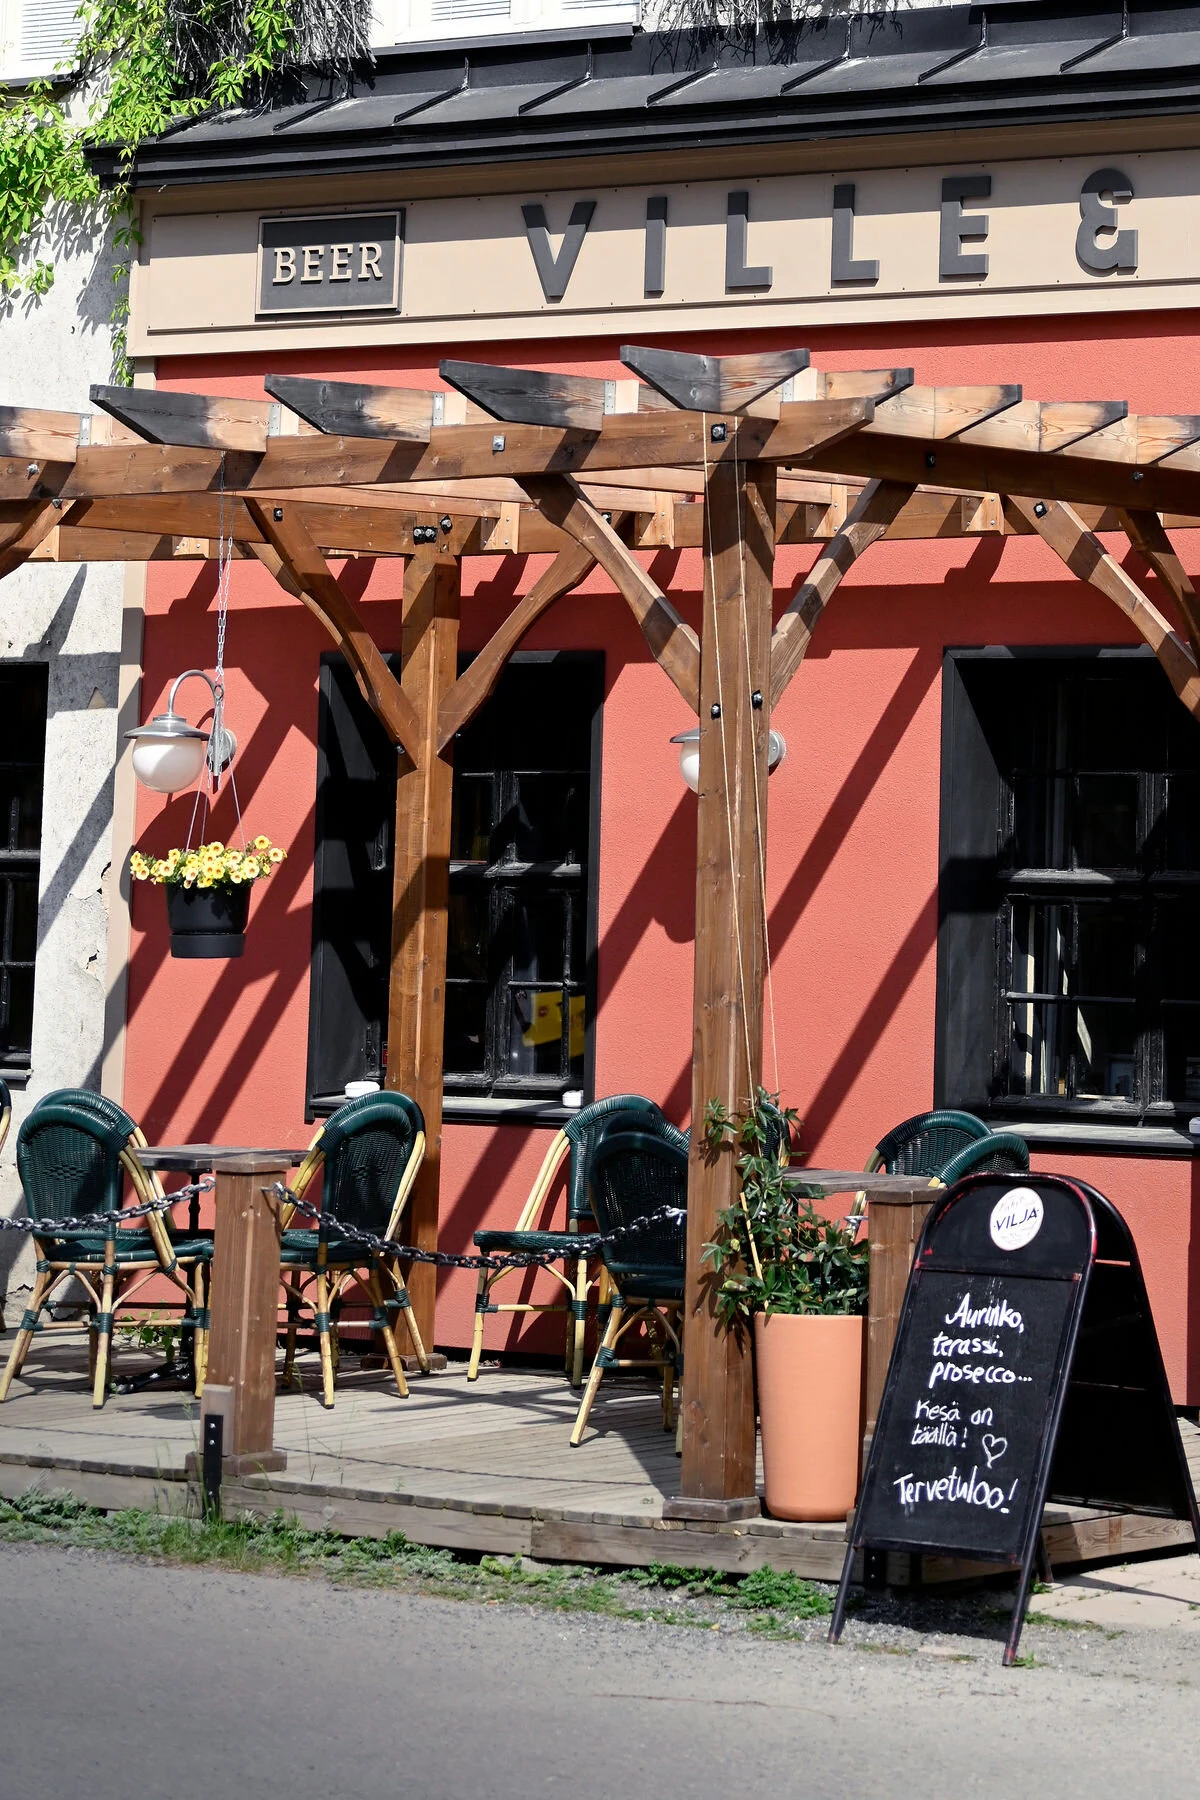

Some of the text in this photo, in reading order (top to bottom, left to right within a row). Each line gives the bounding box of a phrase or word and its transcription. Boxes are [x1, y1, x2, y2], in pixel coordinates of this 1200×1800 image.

[520, 175, 992, 304] VILLE
[1075, 167, 1139, 278] &
[272, 242, 384, 285] BEER
[995, 1207, 1038, 1232] VILJA
[945, 1292, 1025, 1334] Aurinko,
[932, 1331, 1004, 1358] terassi,
[914, 1399, 993, 1426] Kesä on
[893, 1465, 1019, 1514] Tervetuloo!
